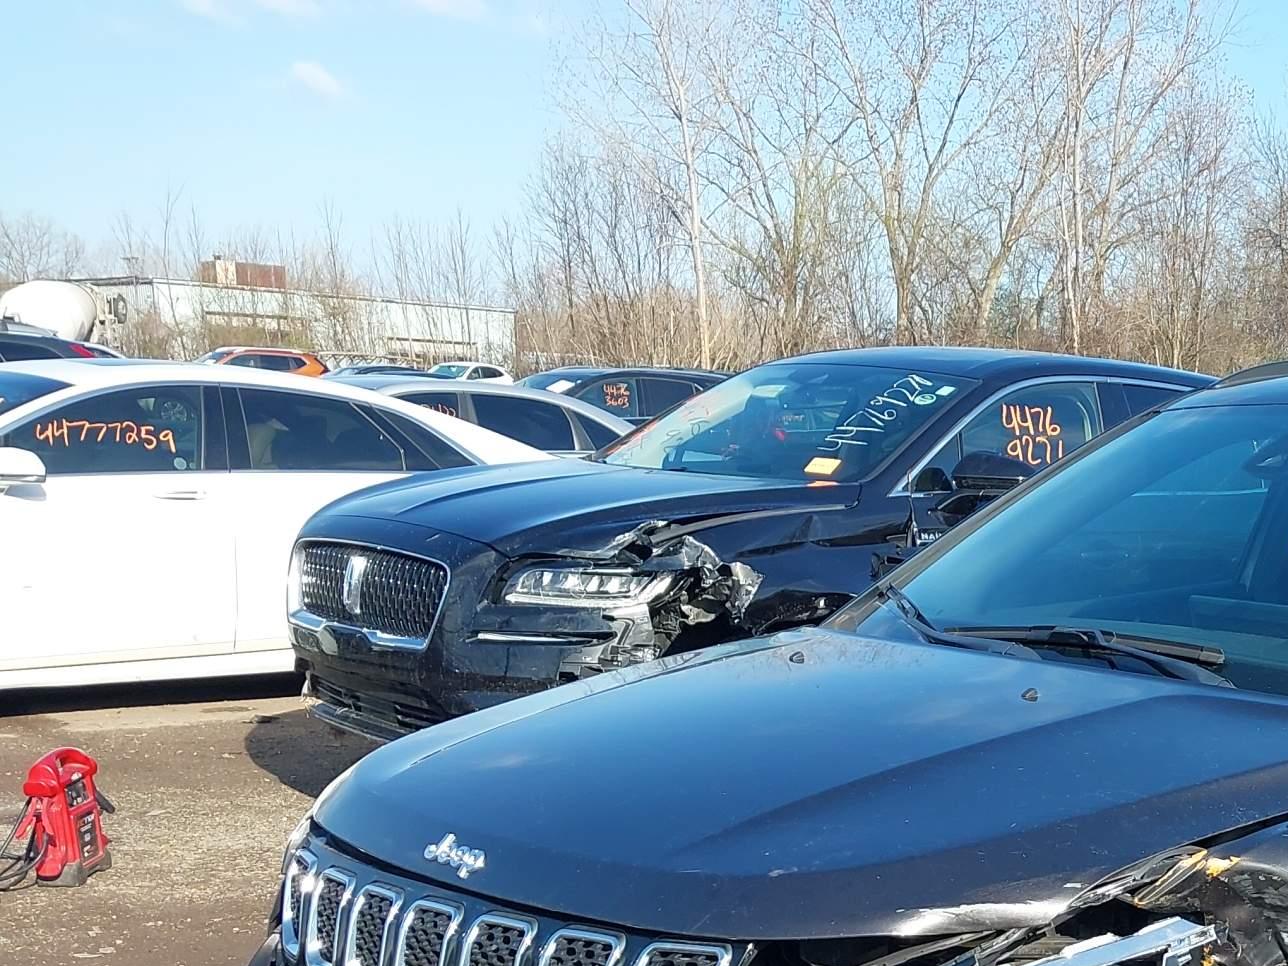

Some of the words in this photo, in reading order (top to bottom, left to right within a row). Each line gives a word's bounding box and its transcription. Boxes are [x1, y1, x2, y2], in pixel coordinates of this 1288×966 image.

[35, 417, 176, 454] 44777259
[1001, 402, 1061, 436] 4476
[1007, 435, 1063, 464] 9271
[424, 832, 485, 880] Jeep
